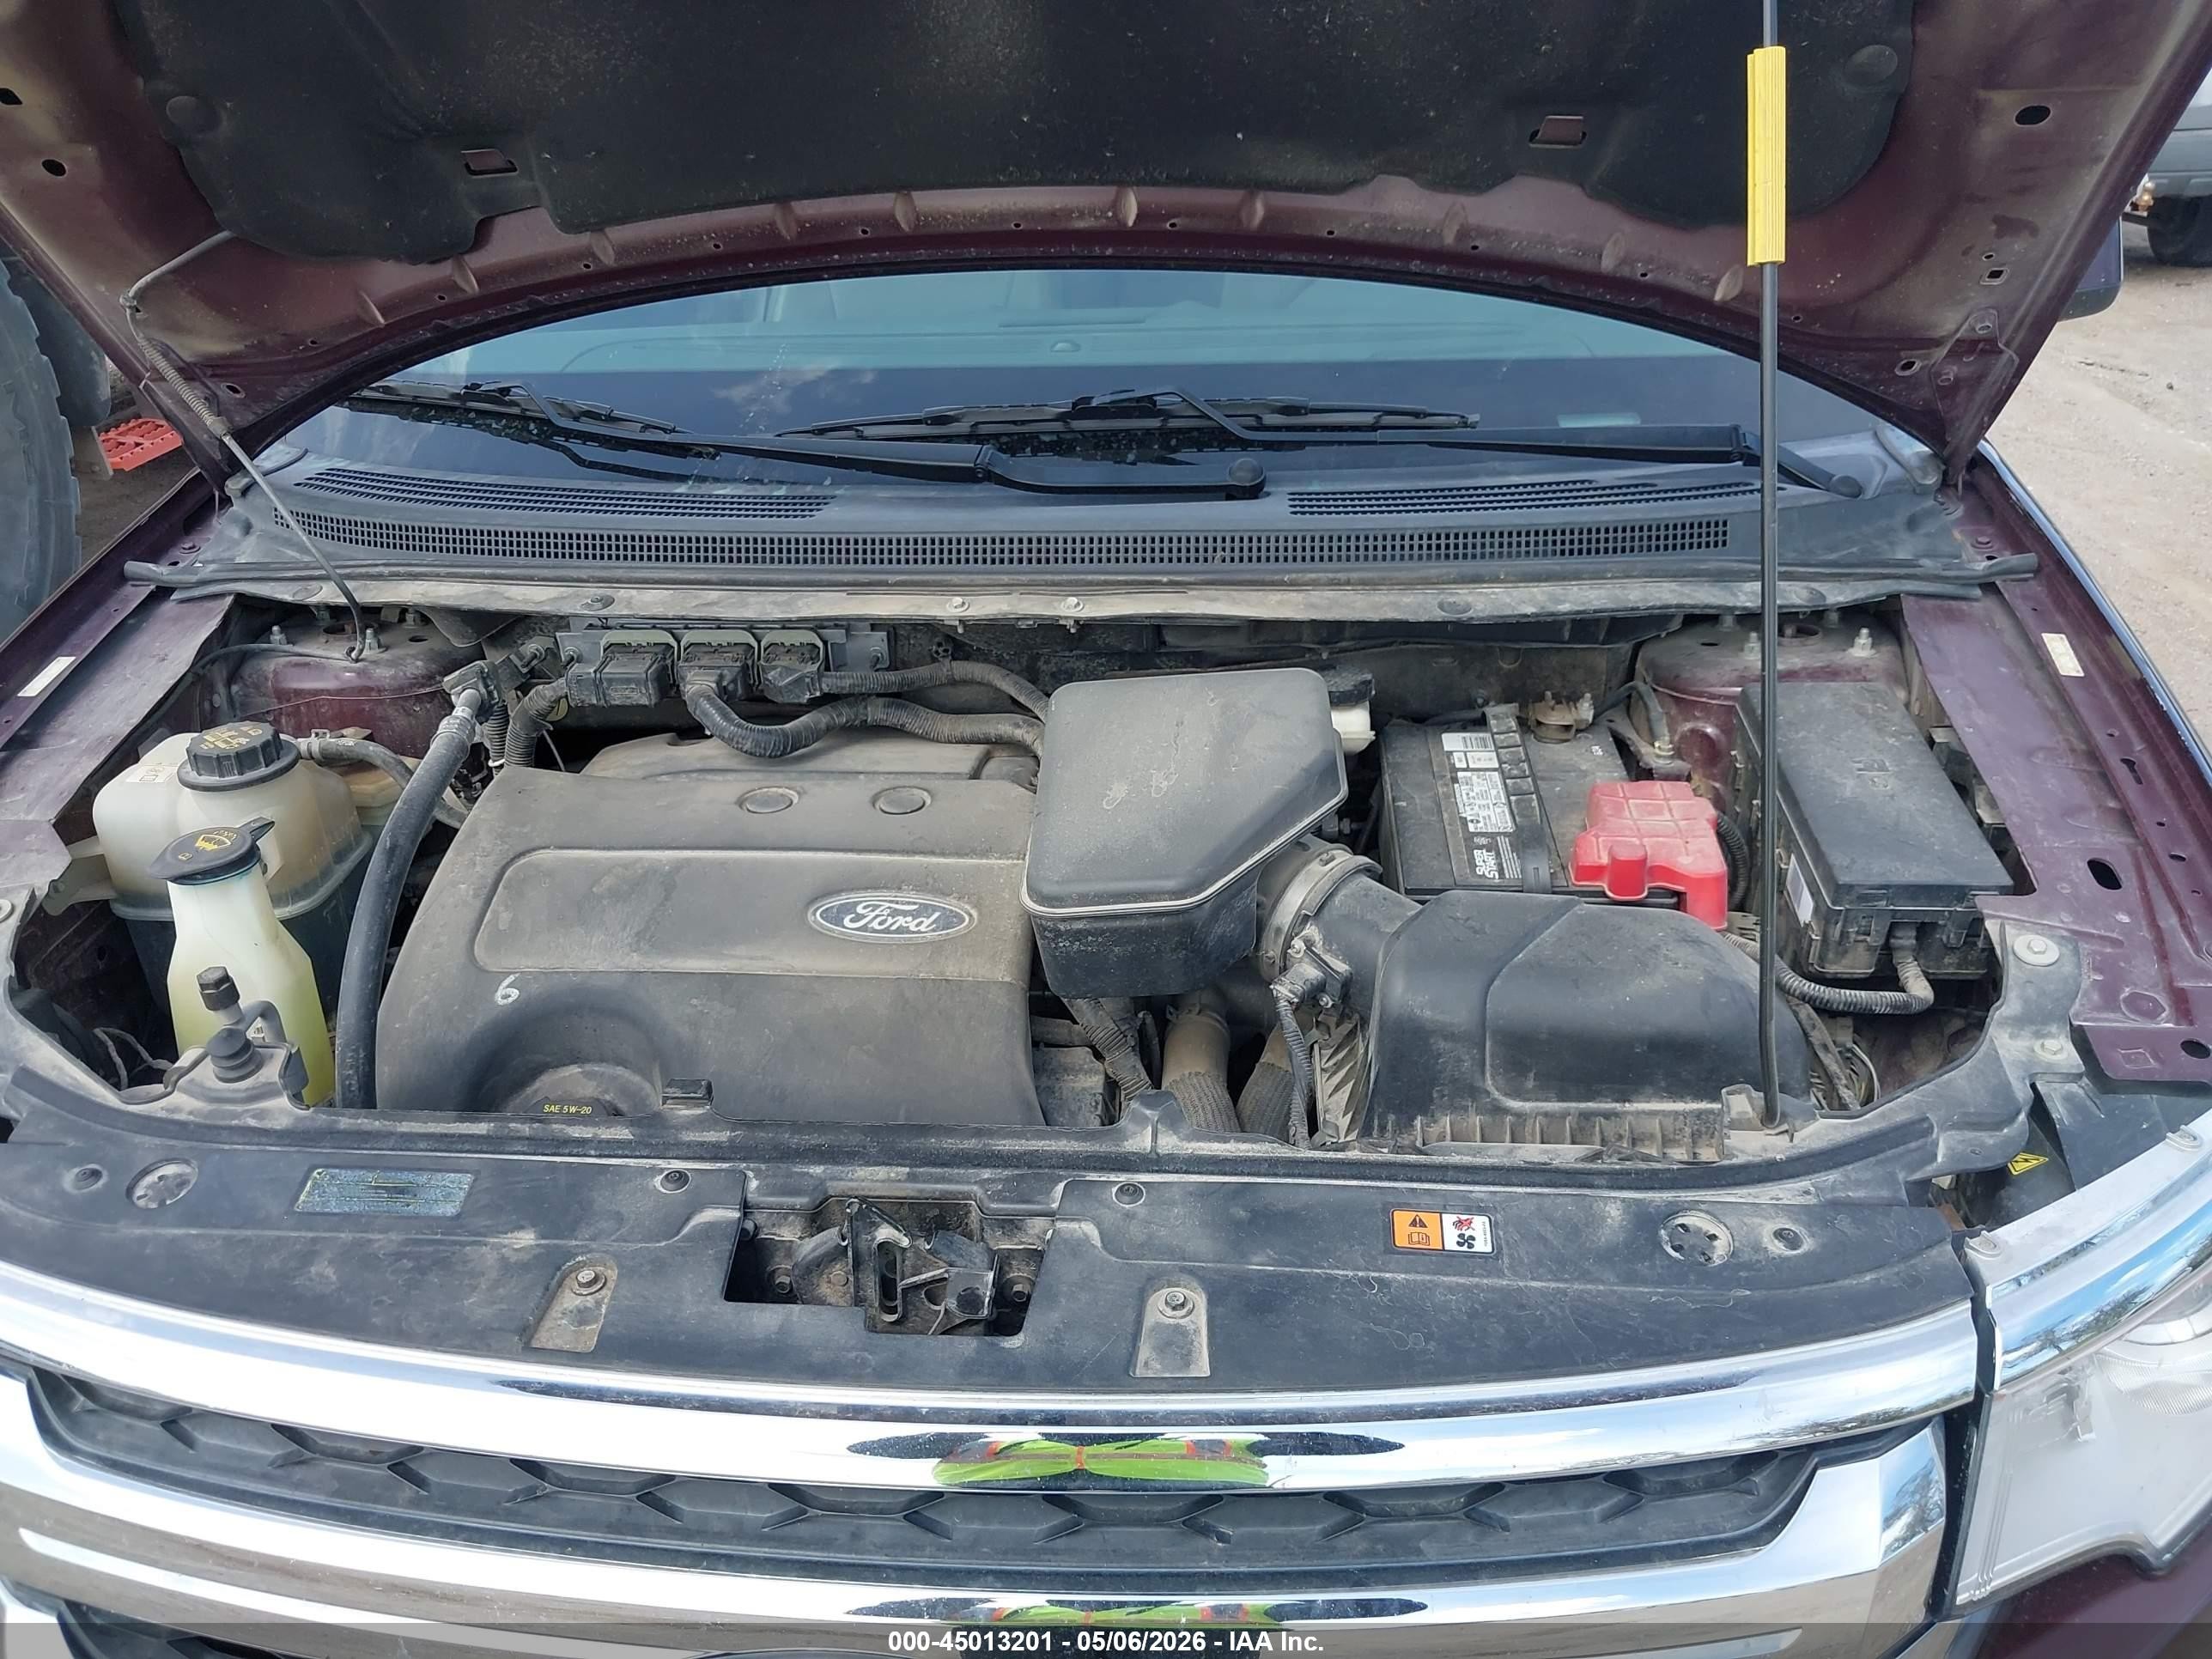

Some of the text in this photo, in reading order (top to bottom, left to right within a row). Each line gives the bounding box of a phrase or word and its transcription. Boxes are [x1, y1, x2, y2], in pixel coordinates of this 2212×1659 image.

[1482, 848, 1499, 879] START
[842, 900, 939, 932] Ford
[494, 973, 520, 1006] 6
[543, 1103, 592, 1115] SAE 5W-20
